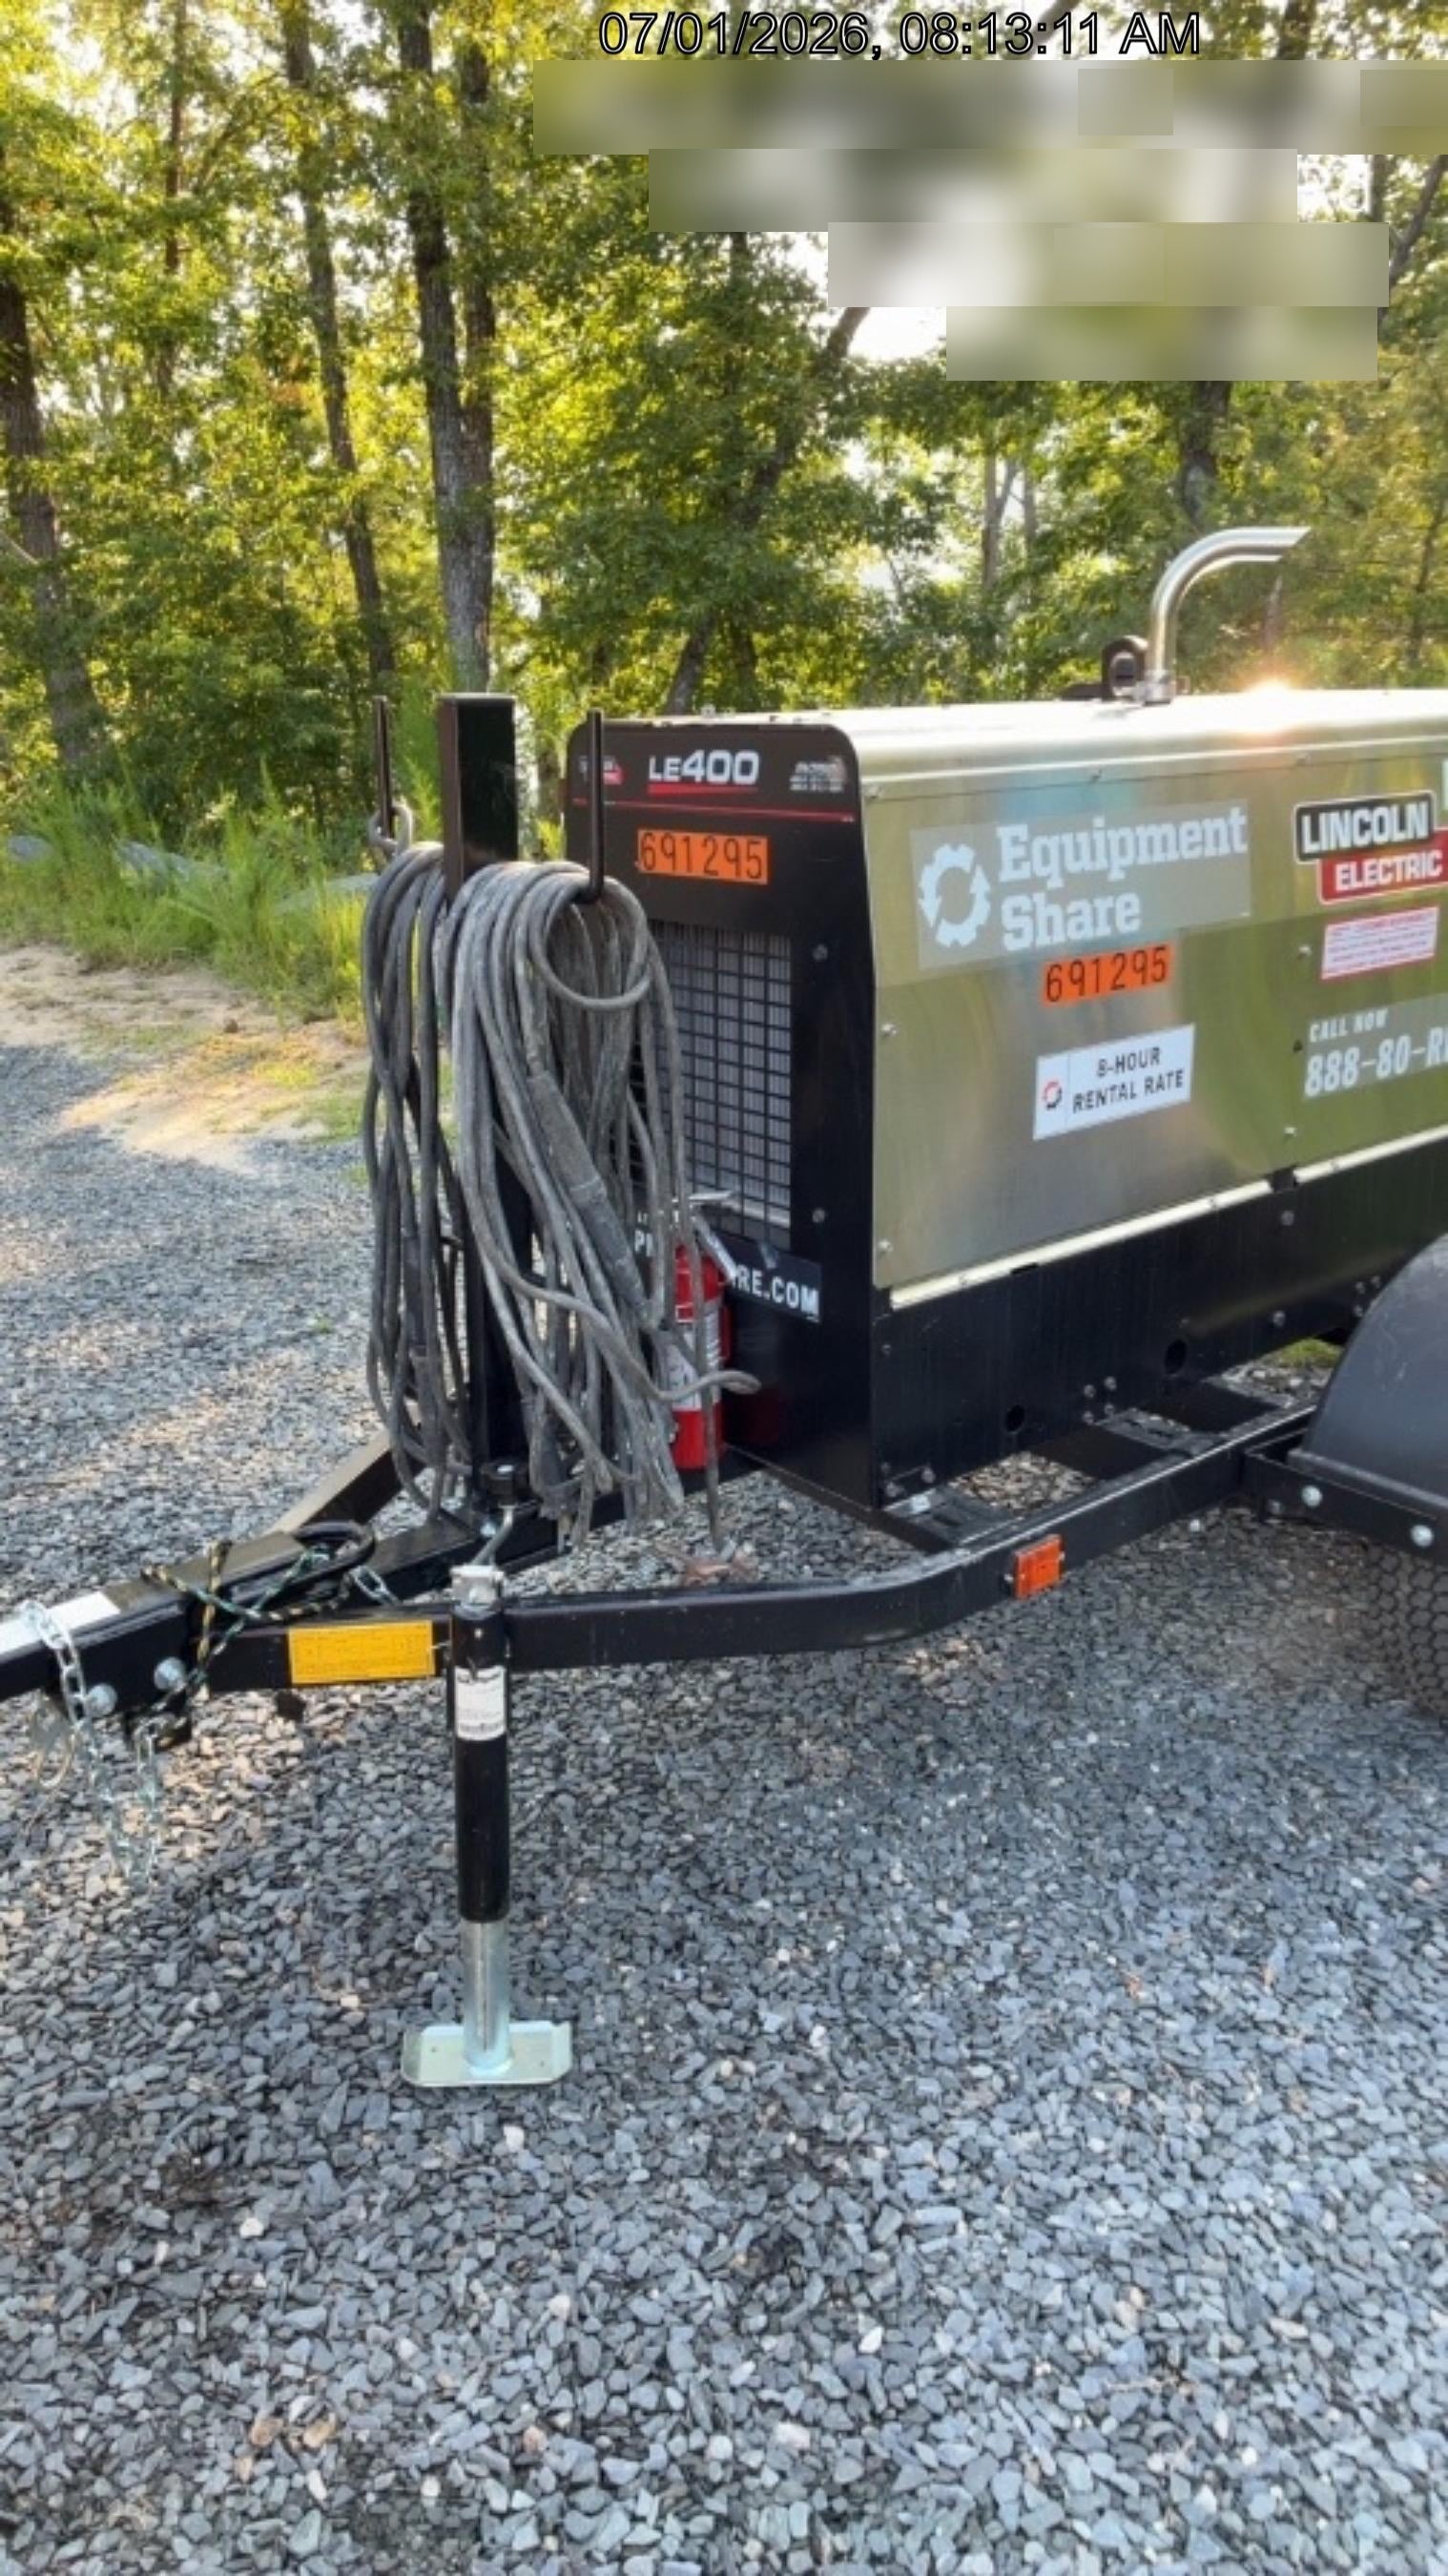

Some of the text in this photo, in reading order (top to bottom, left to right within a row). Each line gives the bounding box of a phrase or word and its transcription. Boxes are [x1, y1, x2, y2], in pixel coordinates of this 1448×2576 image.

[649, 749, 760, 786] LE400
[996, 806, 1248, 890] Equipment
[1301, 800, 1429, 855] LINCOLN
[640, 832, 763, 881] 691295
[1334, 848, 1444, 893] ELECTRIC
[1001, 891, 1142, 951] Share
[1045, 945, 1169, 1003] 691295
[1310, 1016, 1348, 1043] CALL
[1096, 1046, 1161, 1078] 8-HOUR
[1072, 1068, 1185, 1114] RENTAL RATE
[731, 1264, 820, 1316] RE.COM
